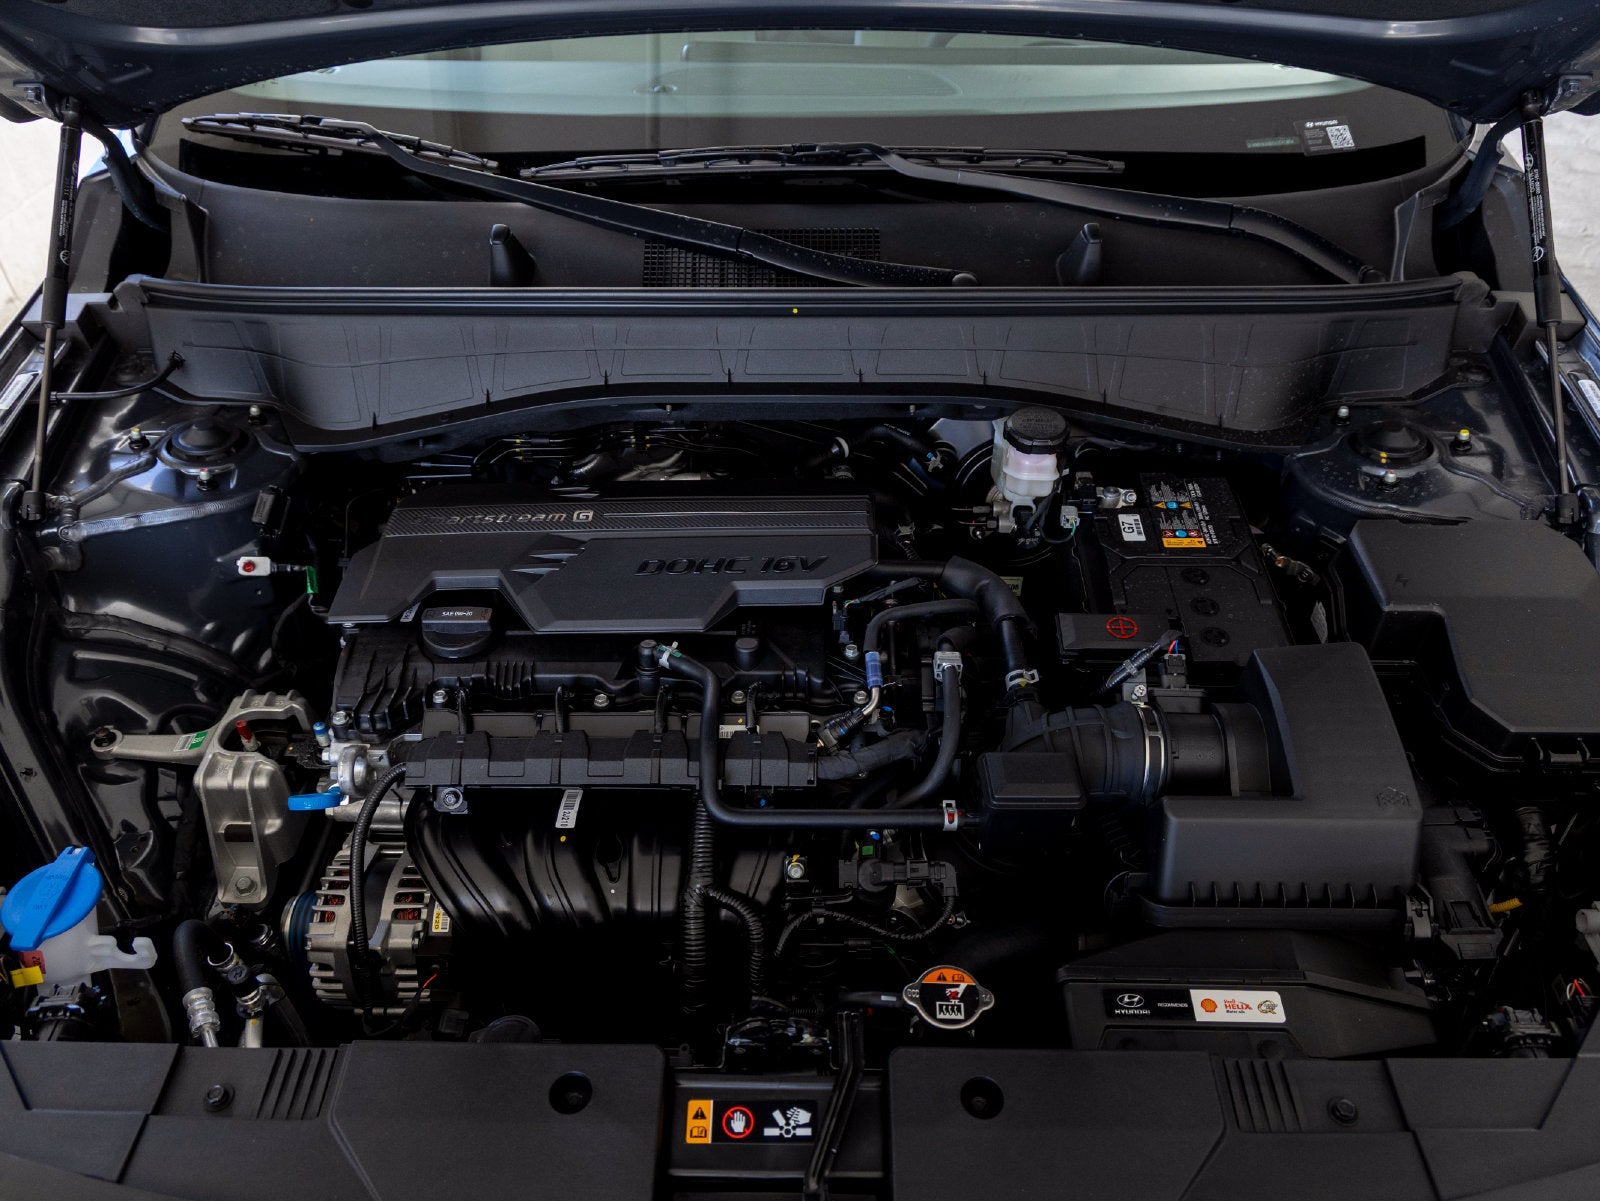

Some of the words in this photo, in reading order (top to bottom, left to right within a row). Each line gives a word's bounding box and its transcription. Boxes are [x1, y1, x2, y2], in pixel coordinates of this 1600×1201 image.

[1122, 521, 1135, 534] G7
[633, 557, 754, 576] DOHC
[760, 555, 829, 574] 16V
[1224, 1003, 1252, 1011] HELIX
